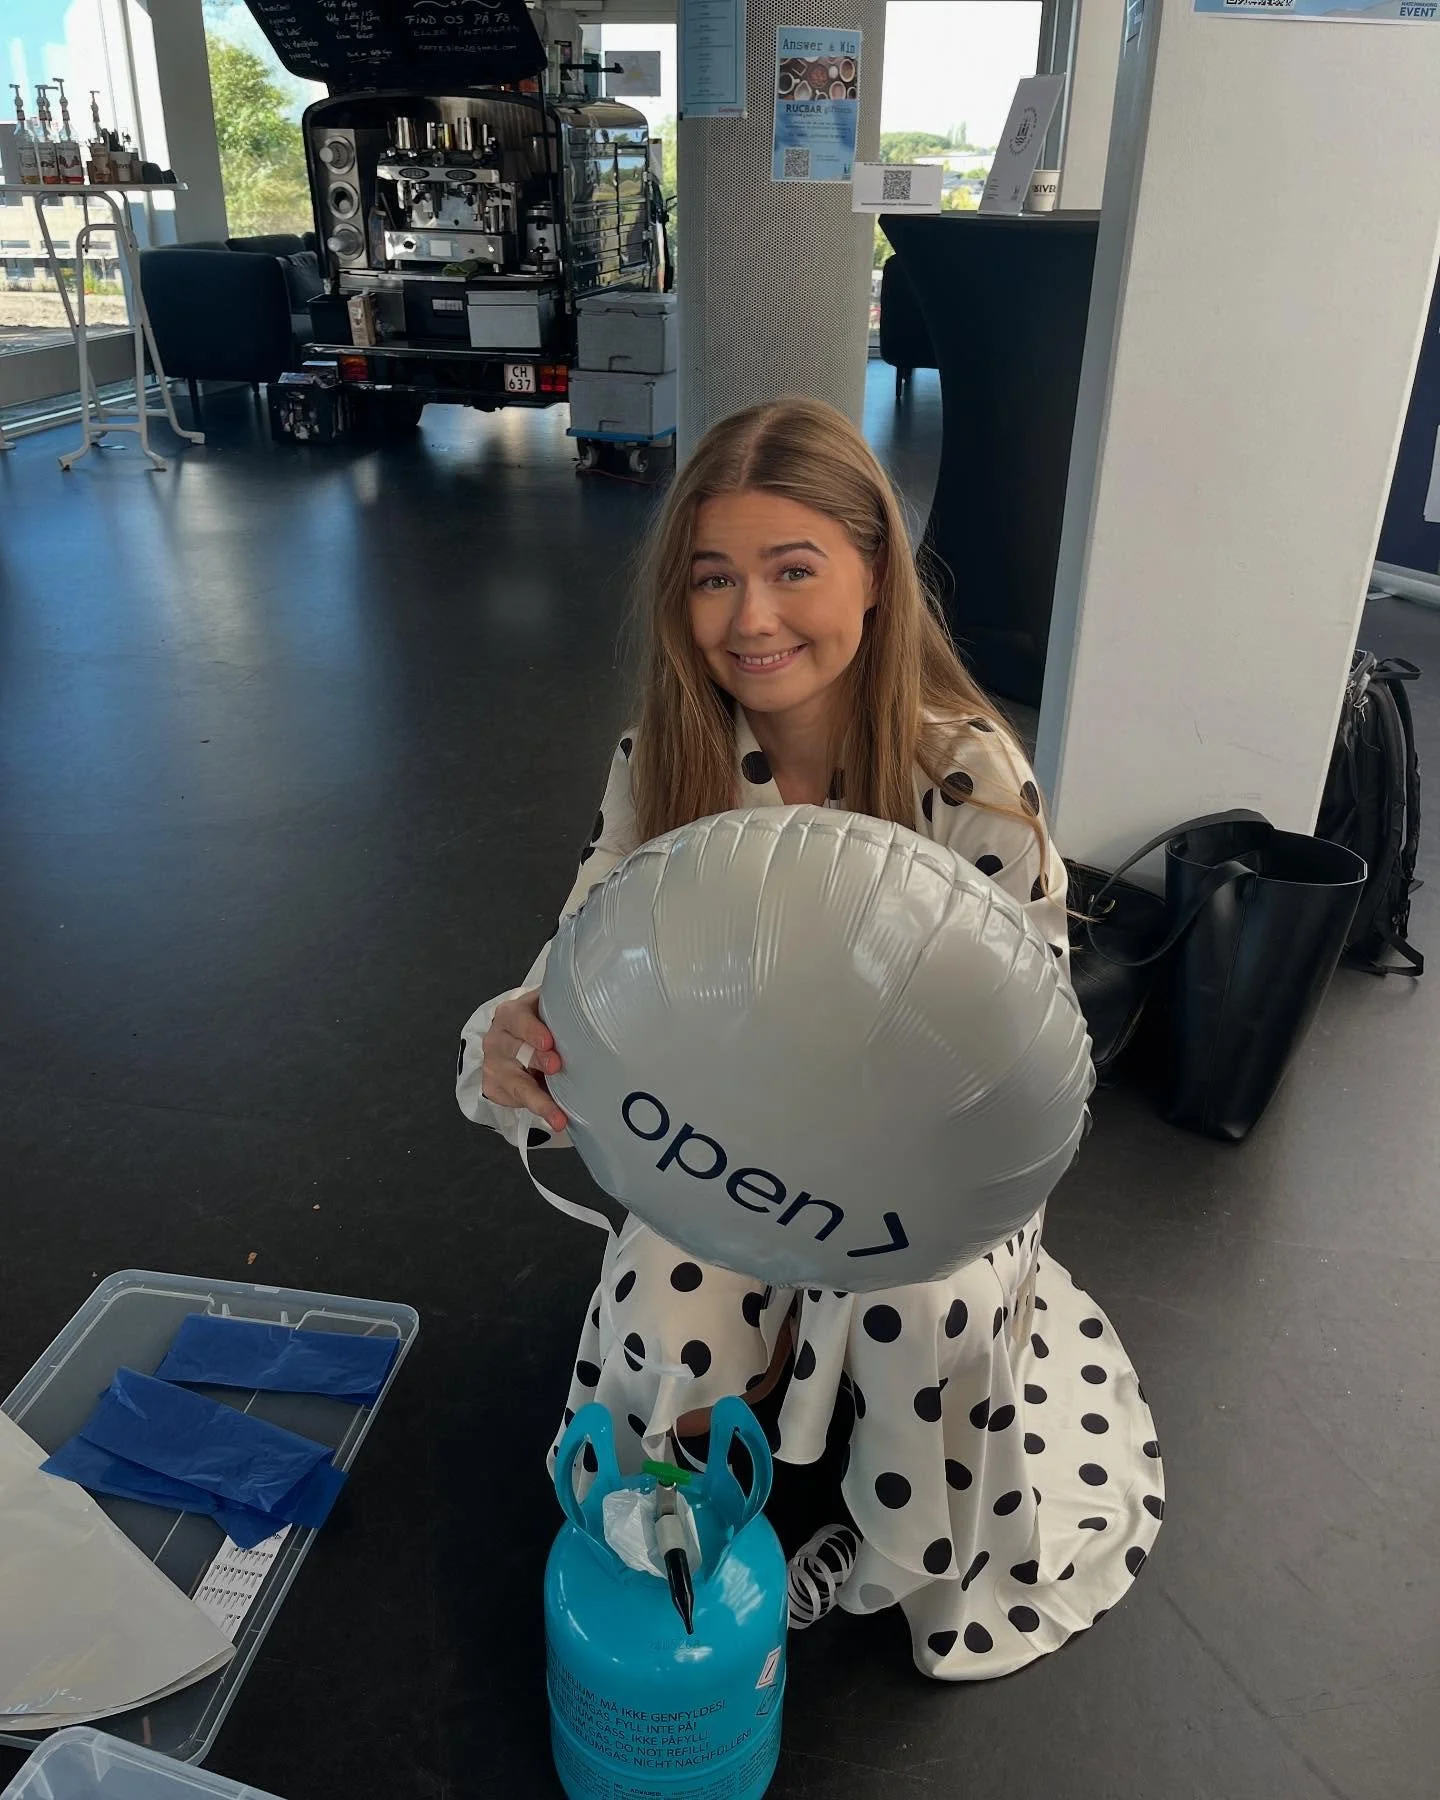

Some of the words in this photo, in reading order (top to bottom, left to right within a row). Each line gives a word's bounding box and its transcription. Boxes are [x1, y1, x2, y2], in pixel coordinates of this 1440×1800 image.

[404, 14, 437, 25] FIND
[443, 15, 465, 25] OS
[473, 11, 489, 25] PÅ
[1400, 7, 1437, 17] EVENT
[783, 38, 823, 51] Answer
[840, 41, 856, 54] Win
[786, 104, 822, 113] RUCBAR
[512, 366, 527, 378] CH
[509, 379, 531, 390] 637
[600, 1696, 617, 1712] MÅ
[621, 1706, 646, 1720] IKKE
[651, 1699, 724, 1721] GENFYLDES!
[616, 1717, 641, 1732] FYLL
[647, 1725, 672, 1733] INTE
[678, 1721, 695, 1733] PÅ!
[632, 1733, 656, 1745] IKKE
[661, 1730, 708, 1745] PÅFYLL!
[615, 1740, 632, 1752] DO
[637, 1746, 663, 1756] NOT
[667, 1742, 708, 1756] REFILL!
[633, 1757, 670, 1768] NICHT
[675, 1726, 752, 1767] NACHFÜLLEN!
